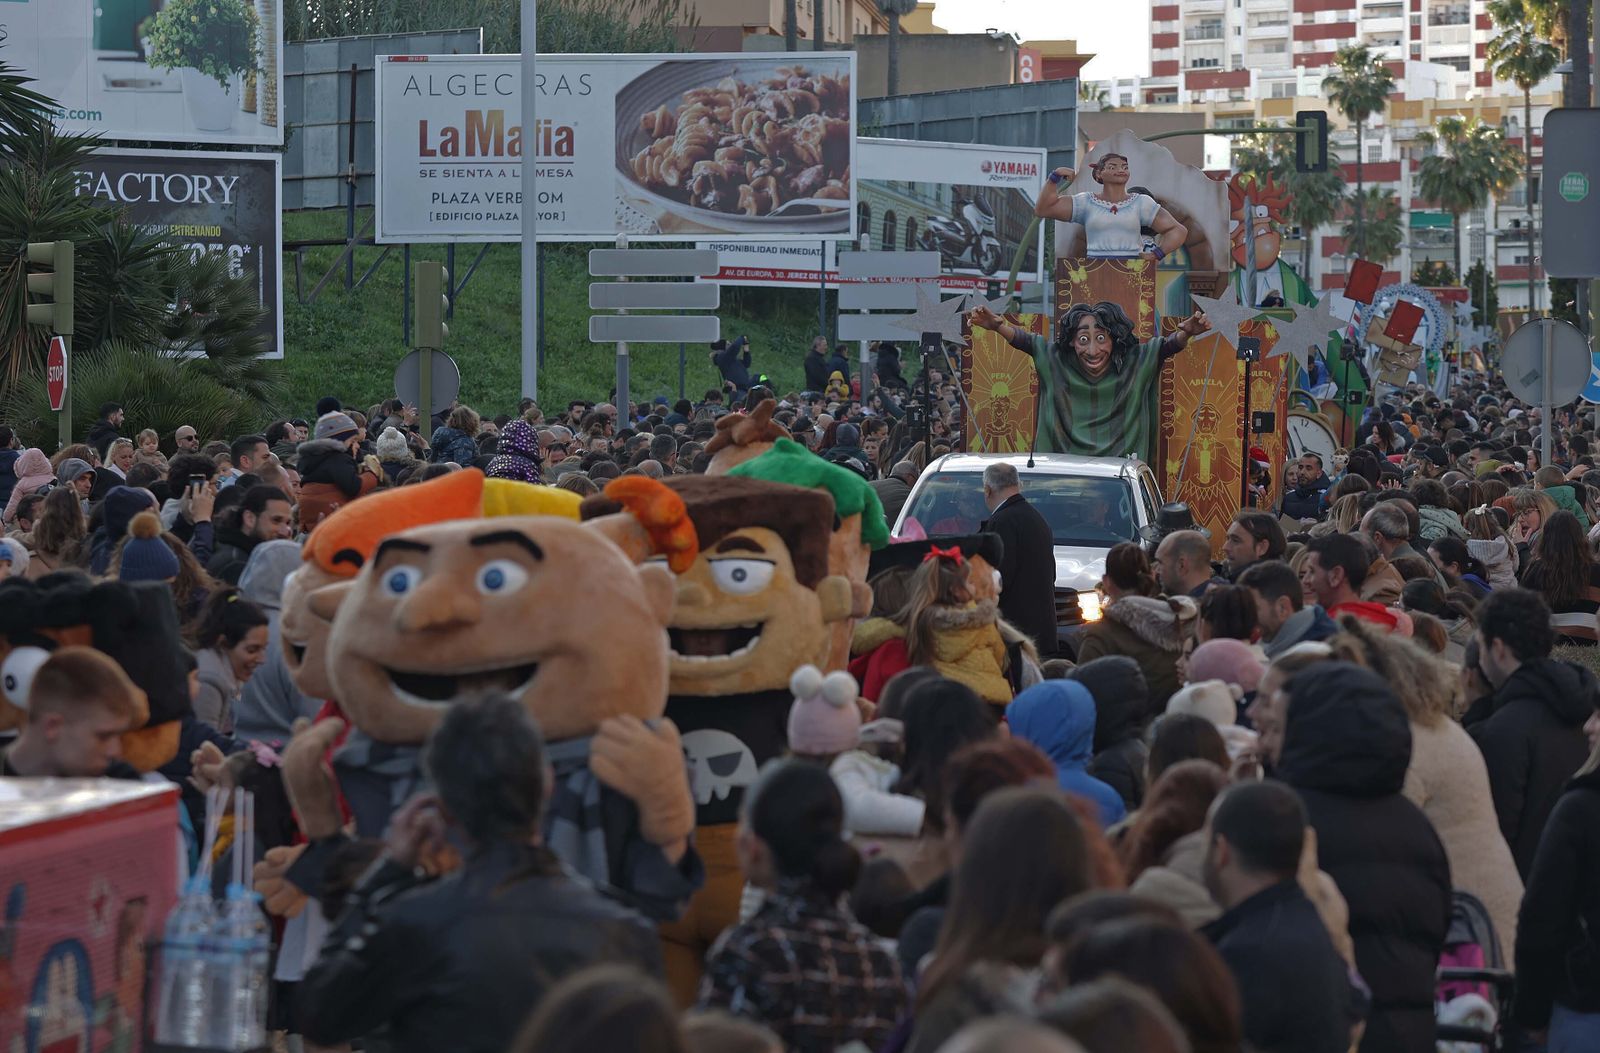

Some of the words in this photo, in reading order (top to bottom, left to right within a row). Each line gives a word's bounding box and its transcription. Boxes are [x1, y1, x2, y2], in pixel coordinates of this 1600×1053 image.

[403, 73, 592, 96] ALGECRAS
[419, 169, 437, 178] SE
[442, 169, 493, 178] SIENTA
[498, 169, 506, 177] A
[536, 169, 574, 178] MESA
[994, 161, 1037, 176] YAMAHA
[73, 171, 240, 204] FACTORY
[432, 192, 480, 204] PLAZA
[485, 192, 563, 204] VERBOM
[486, 213, 519, 221] PLAZA
[170, 224, 221, 237] ENTRENANDO
[709, 244, 778, 254] DISPONIBILIDAD
[49, 366, 63, 382] STOP
[1250, 370, 1272, 378] ULIETA
